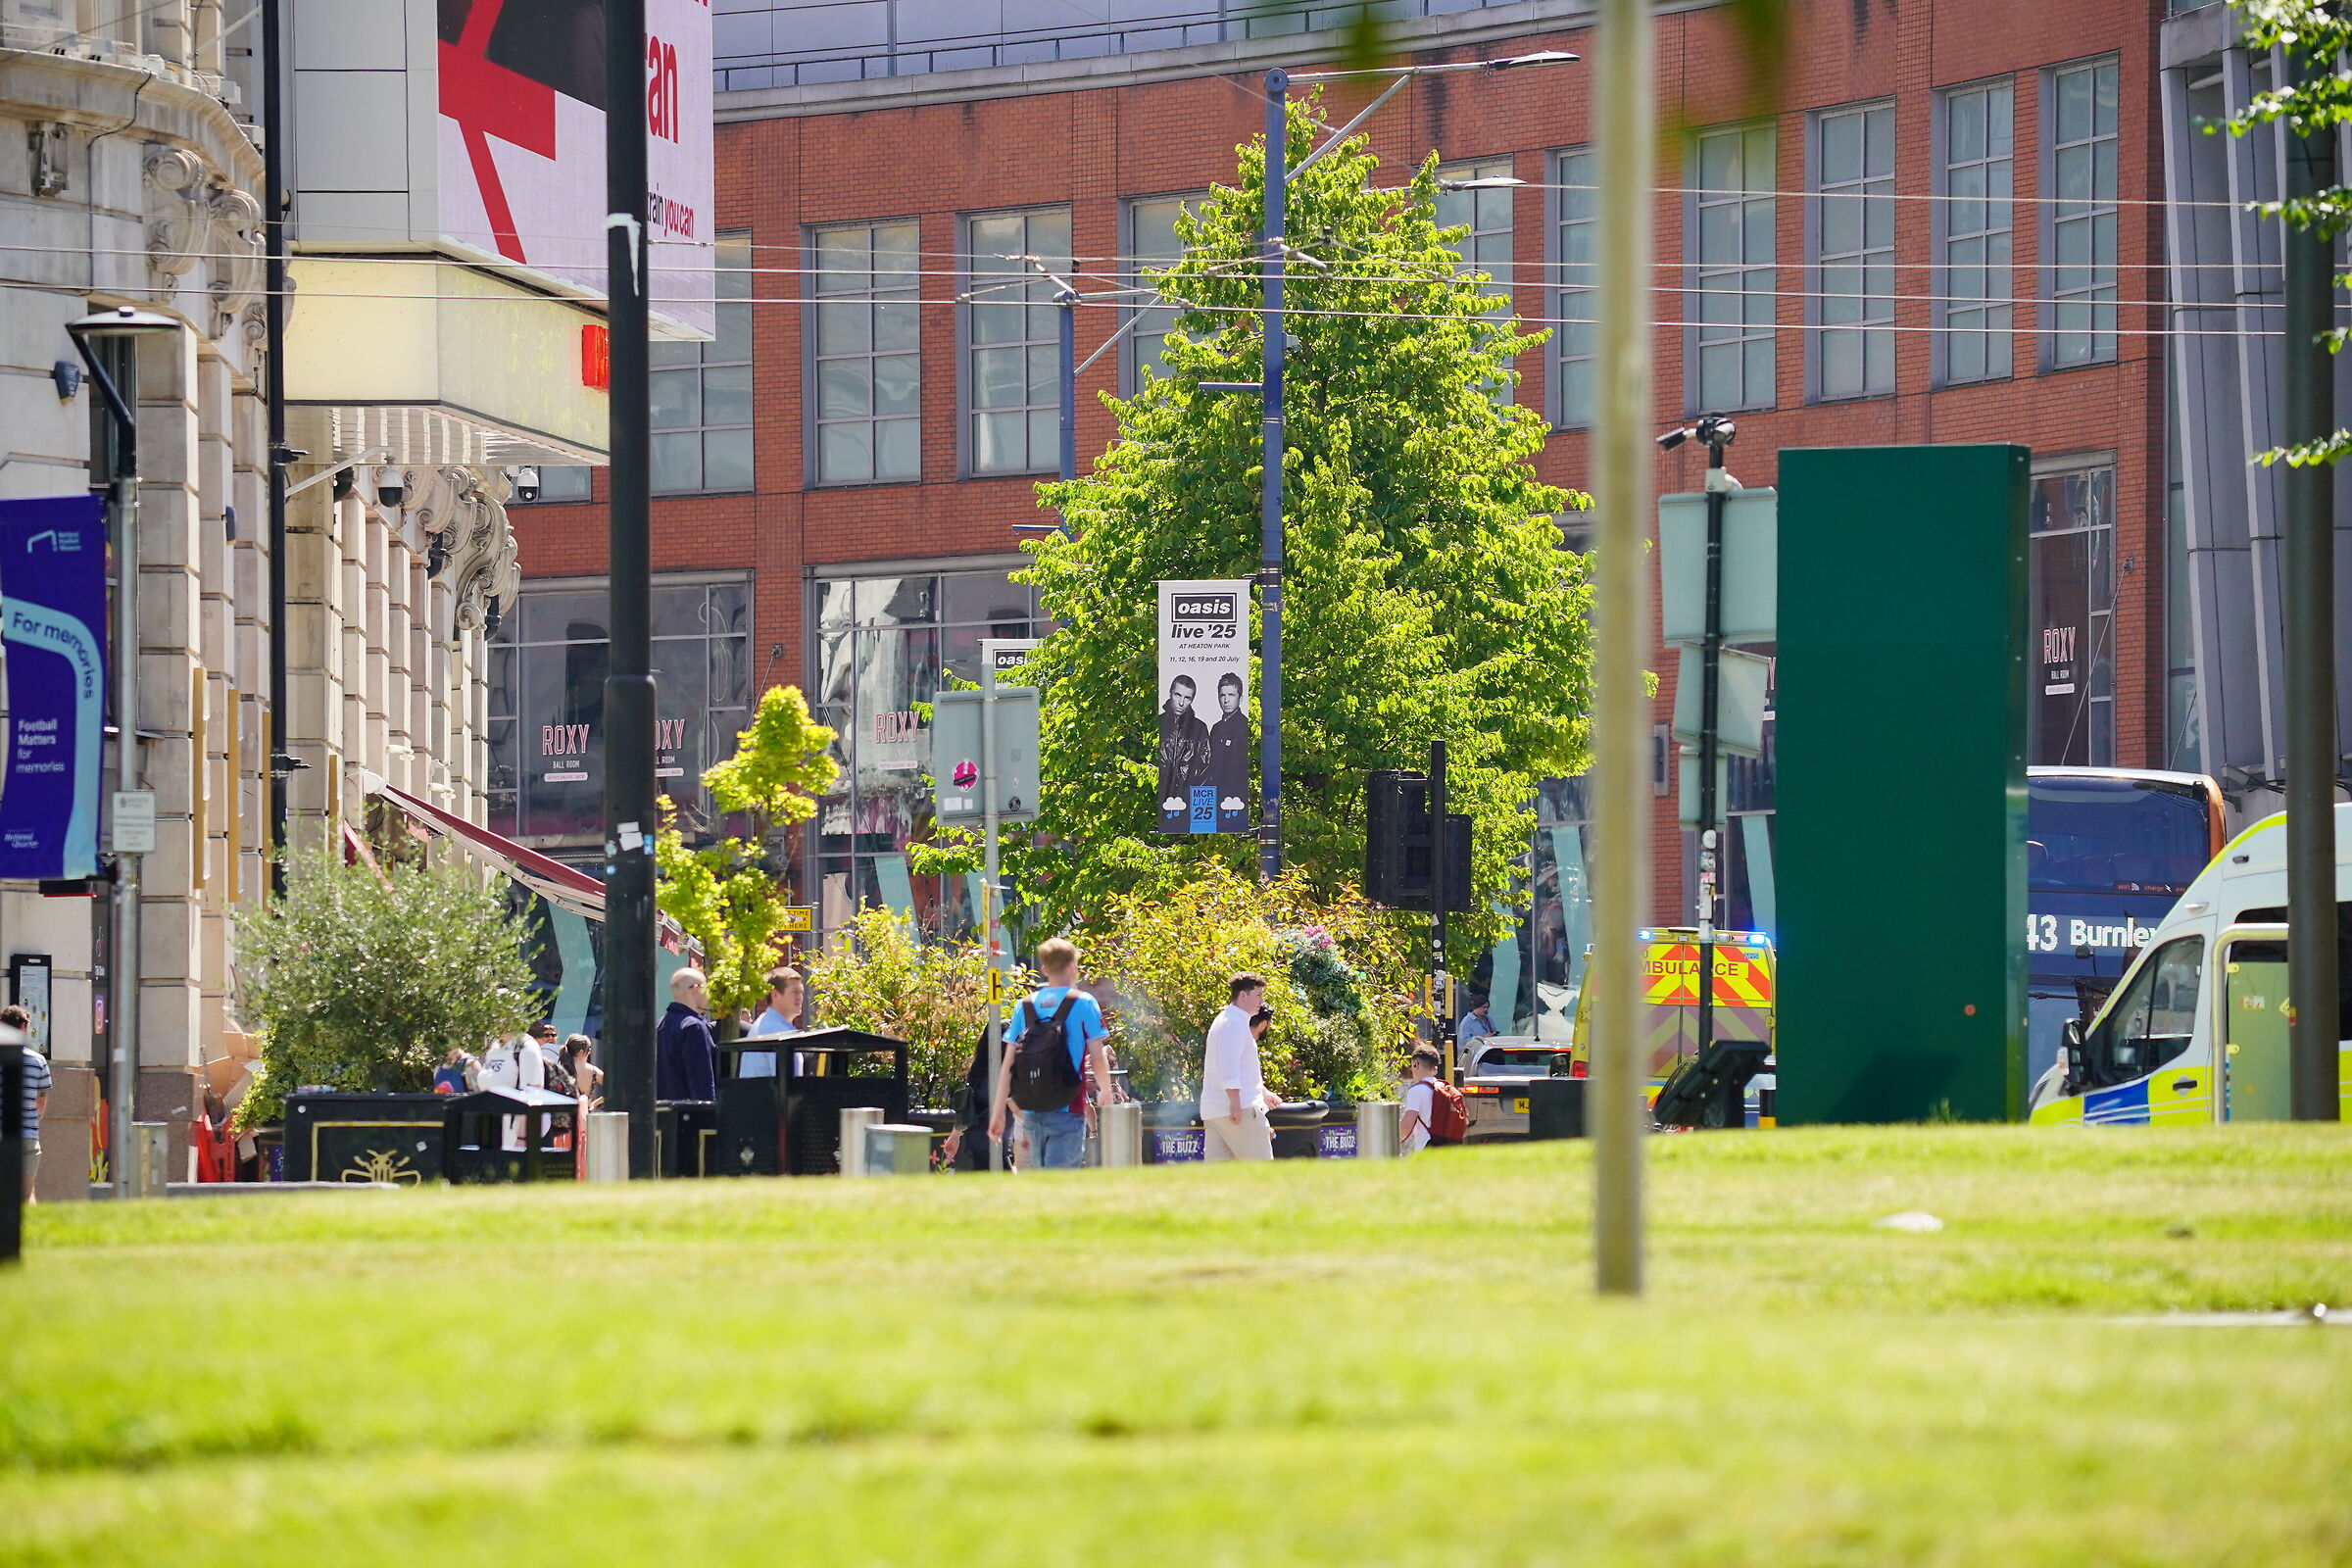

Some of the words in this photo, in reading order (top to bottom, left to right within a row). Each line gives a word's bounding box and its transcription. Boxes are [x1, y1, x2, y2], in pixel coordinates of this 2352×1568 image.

[1177, 599, 1231, 614] oasis
[1171, 624, 1204, 638] live
[2043, 627, 2077, 663] ROXY
[13, 612, 41, 634] For
[44, 625, 95, 700] memories
[18, 718, 58, 732] Football
[875, 710, 920, 743] ROXY
[18, 734, 57, 746] Matters
[542, 724, 590, 755] ROXY
[17, 748, 32, 760] for
[16, 761, 66, 774] memories
[565, 760, 580, 768] ROOM
[1193, 798, 1213, 807] LIVE
[1193, 807, 1213, 820] 25
[1639, 959, 1739, 977] MBULACE
[1161, 1141, 1176, 1153] THE
[1177, 1141, 1198, 1153] BUZZ
[1326, 1136, 1339, 1149] THE
[1340, 1135, 1355, 1149] BUZZ
